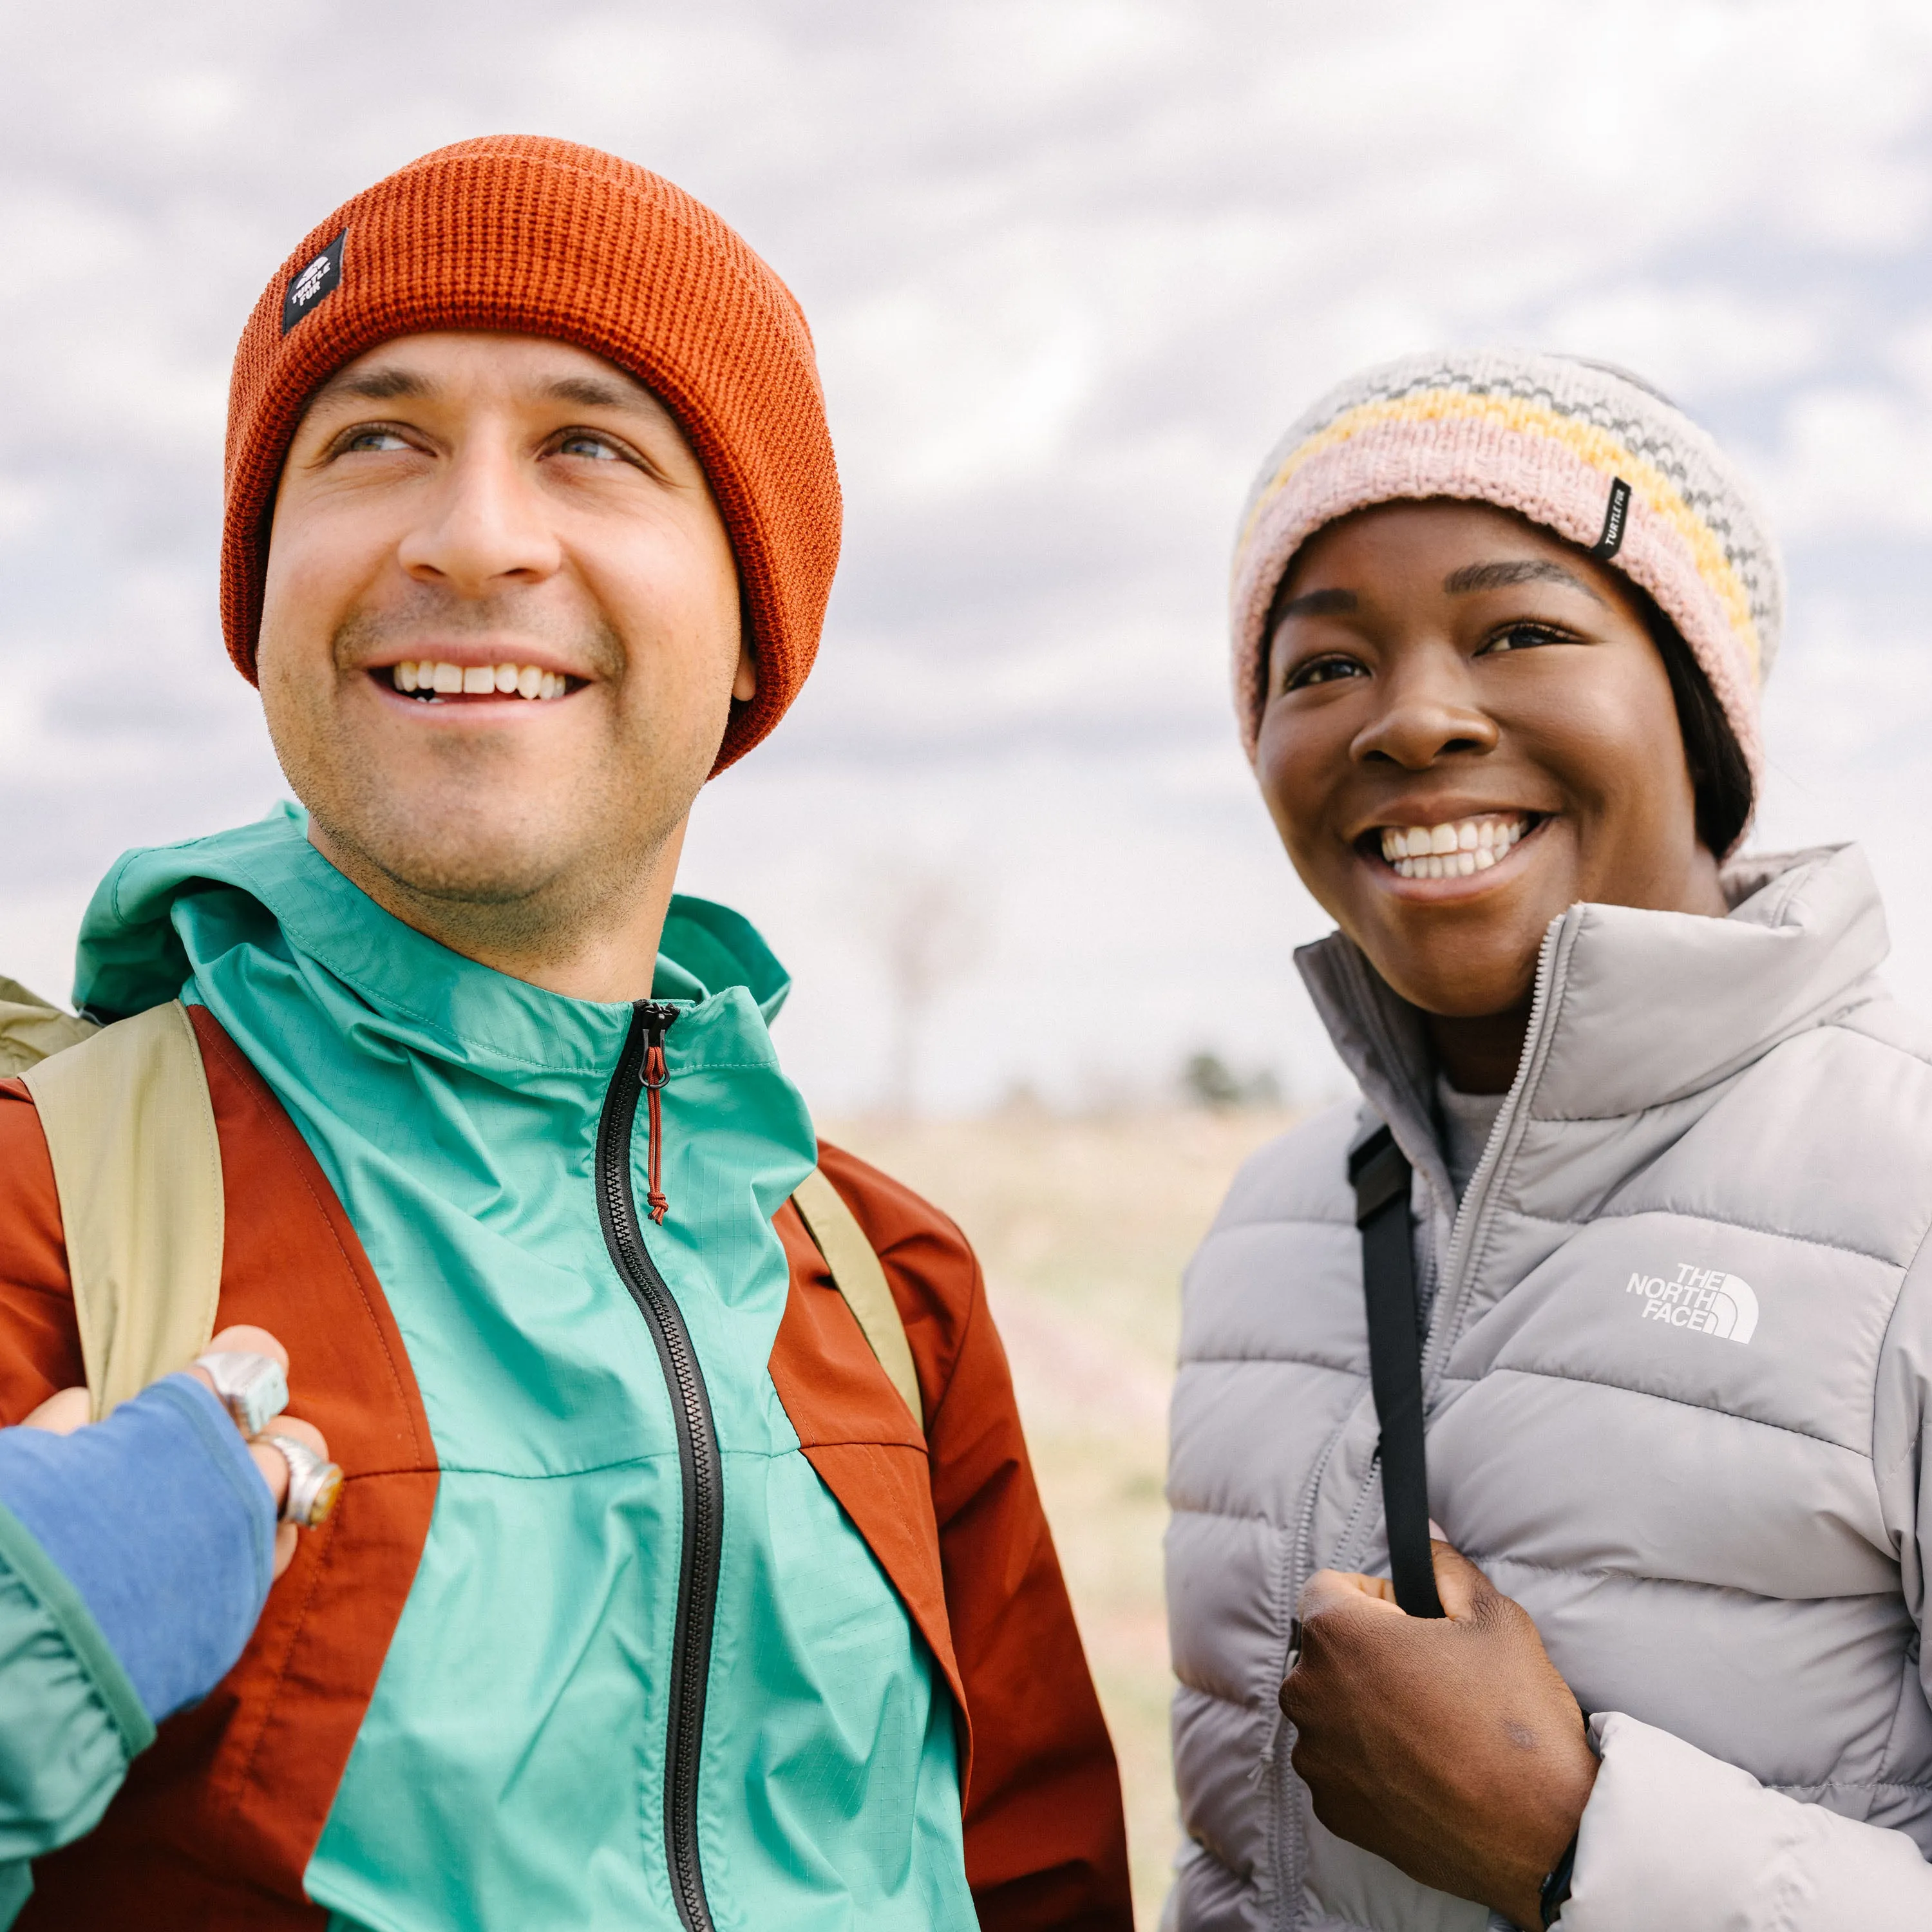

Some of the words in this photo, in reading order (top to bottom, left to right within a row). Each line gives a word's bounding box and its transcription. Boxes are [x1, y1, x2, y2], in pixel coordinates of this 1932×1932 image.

[292, 262, 331, 305] TURTLE
[299, 281, 321, 307] FUR
[1605, 506, 1622, 546] TURTLE
[1625, 1273, 1718, 1311] NORTH
[1677, 1262, 1727, 1291] THE
[1642, 1299, 1709, 1331] FACE
